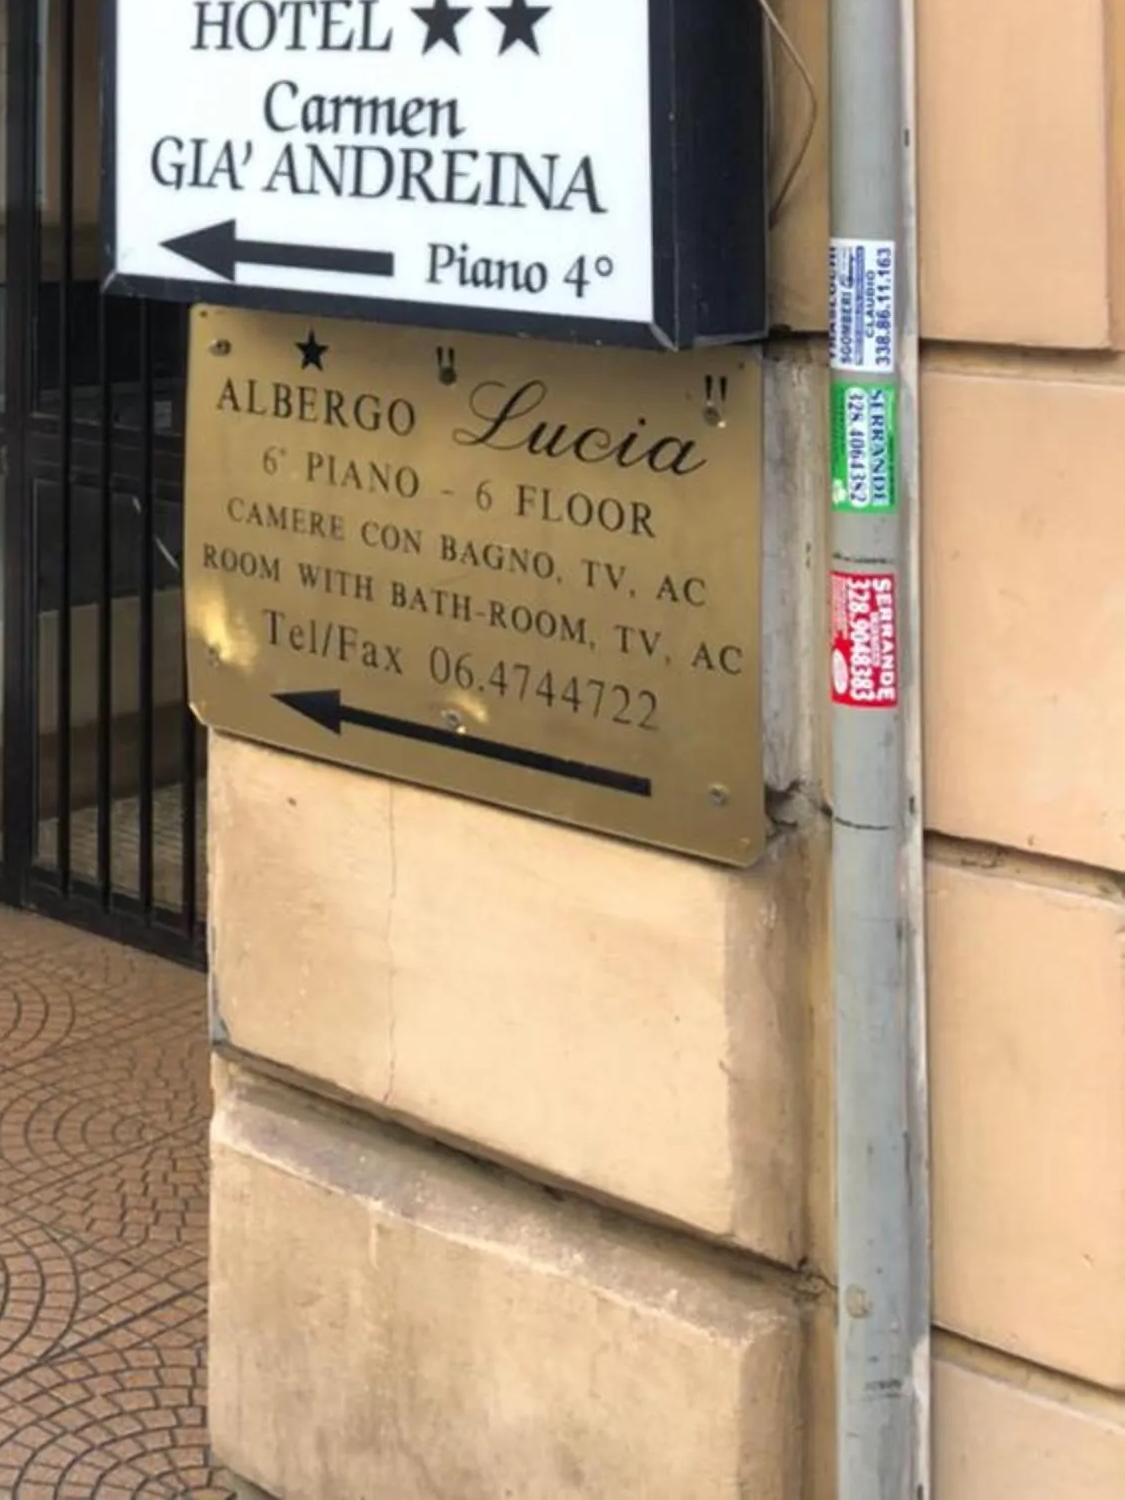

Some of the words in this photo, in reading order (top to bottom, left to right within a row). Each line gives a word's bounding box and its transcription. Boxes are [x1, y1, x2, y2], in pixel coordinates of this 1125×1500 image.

[263, 79, 467, 139] Carmen
[263, 142, 609, 215] ANDREINA
[425, 242, 549, 294] Piano
[564, 254, 615, 298] 4°
[865, 269, 876, 338] CLAUDIO
[216, 376, 416, 437] ALBERGO
[452, 379, 707, 476] Lucia
[870, 388, 887, 500] SERRANDE
[306, 451, 420, 499] PIANO
[516, 483, 656, 539] FLOOR
[227, 496, 346, 541] CAMERE
[361, 520, 424, 555] CON
[440, 534, 563, 585] BAGNO,
[581, 558, 636, 599] TV,
[656, 574, 706, 608] AC
[202, 541, 281, 583] ROOM
[297, 562, 375, 603] WITH
[390, 581, 597, 650] BATH-ROOM,
[615, 624, 672, 667] TV,
[691, 642, 744, 676] AC
[873, 577, 895, 701] SERRANDE
[262, 609, 404, 676] Tel/Fax
[429, 645, 659, 732] 06.4744722
